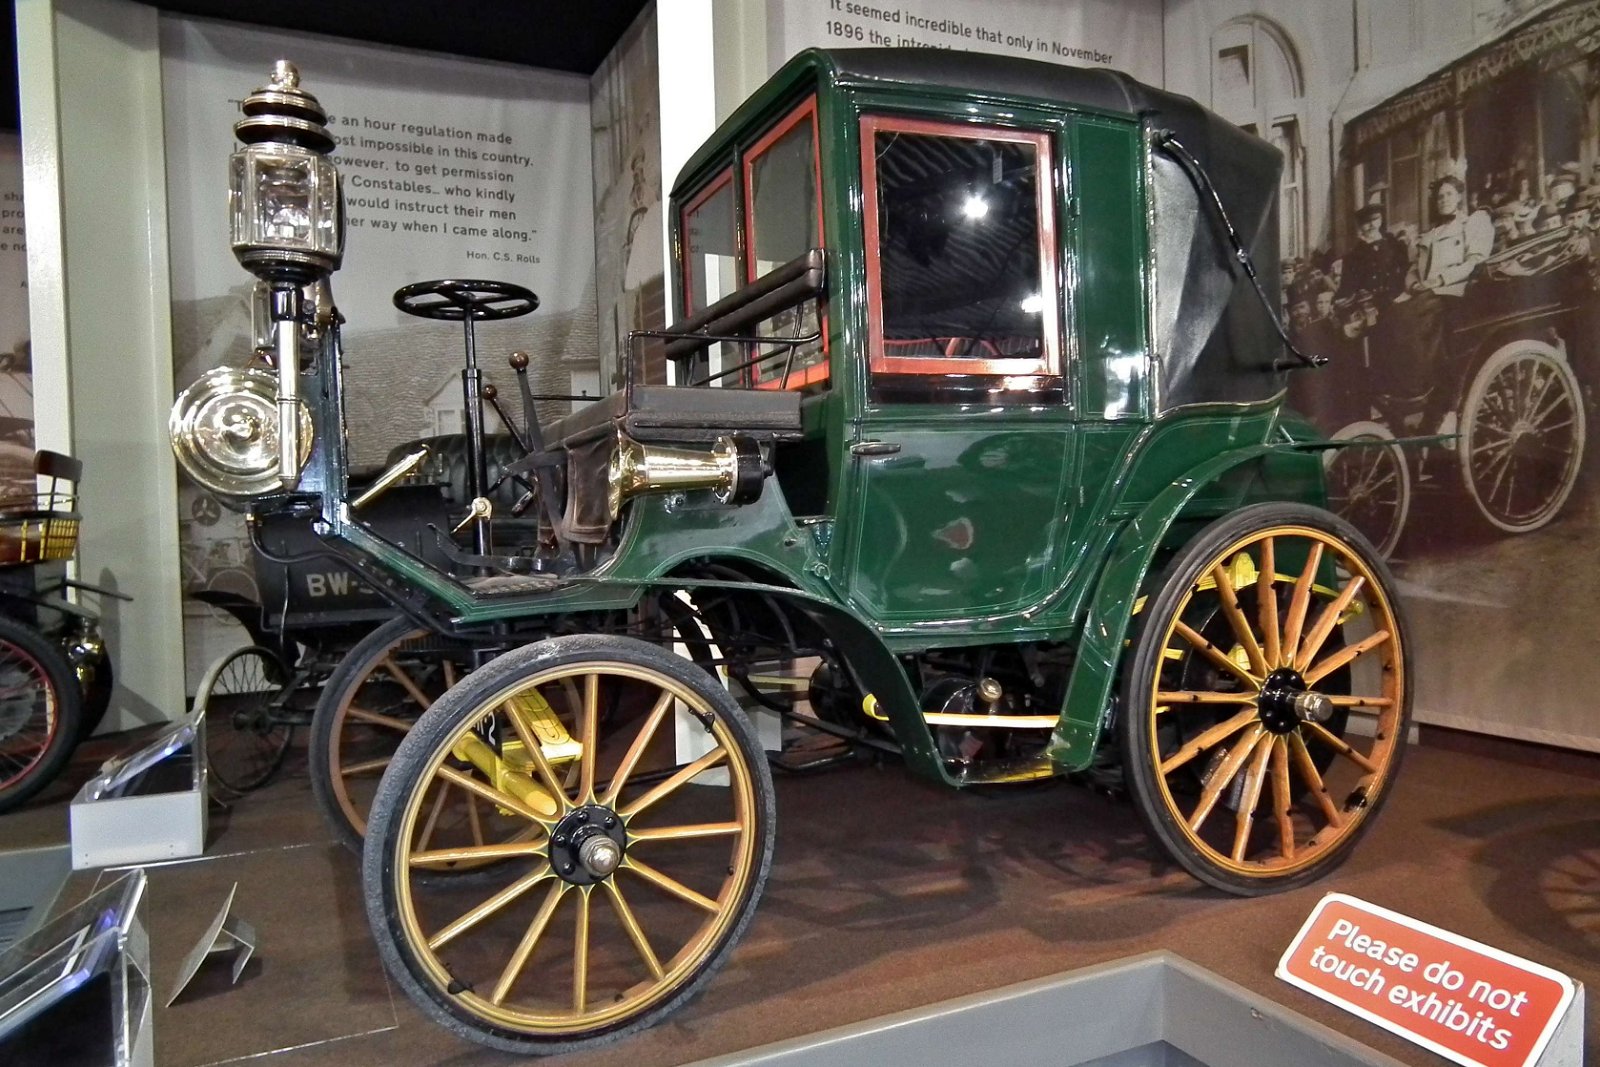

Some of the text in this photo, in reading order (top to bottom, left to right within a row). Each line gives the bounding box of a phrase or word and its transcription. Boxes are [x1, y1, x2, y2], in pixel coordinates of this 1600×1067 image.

[826, 21, 864, 41] 1896
[869, 29, 892, 47] the
[846, 1, 900, 23] seemed
[905, 11, 972, 38] incredible
[976, 26, 1003, 44] that
[1006, 35, 1033, 52] only
[1036, 38, 1048, 52] in
[1052, 41, 1113, 64] November
[342, 116, 359, 127] an
[364, 116, 396, 131] hour
[401, 123, 472, 141] regulation
[477, 132, 513, 145] made
[360, 136, 434, 156] impossible
[438, 145, 450, 157] in
[454, 146, 478, 160] this
[481, 151, 534, 168] country.
[395, 160, 410, 172] to
[415, 163, 437, 176] get
[442, 166, 514, 183] permission
[444, 184, 471, 198] who
[476, 187, 515, 203] kindly
[346, 196, 516, 221] would instruct their men
[370, 219, 398, 232] way
[402, 220, 438, 234] when
[443, 222, 447, 234] I
[453, 225, 488, 237] came
[466, 250, 541, 264] Hon. C.S. Rolls
[1327, 918, 1528, 1017] Please do not
[1309, 945, 1512, 1050] touch exhibits
